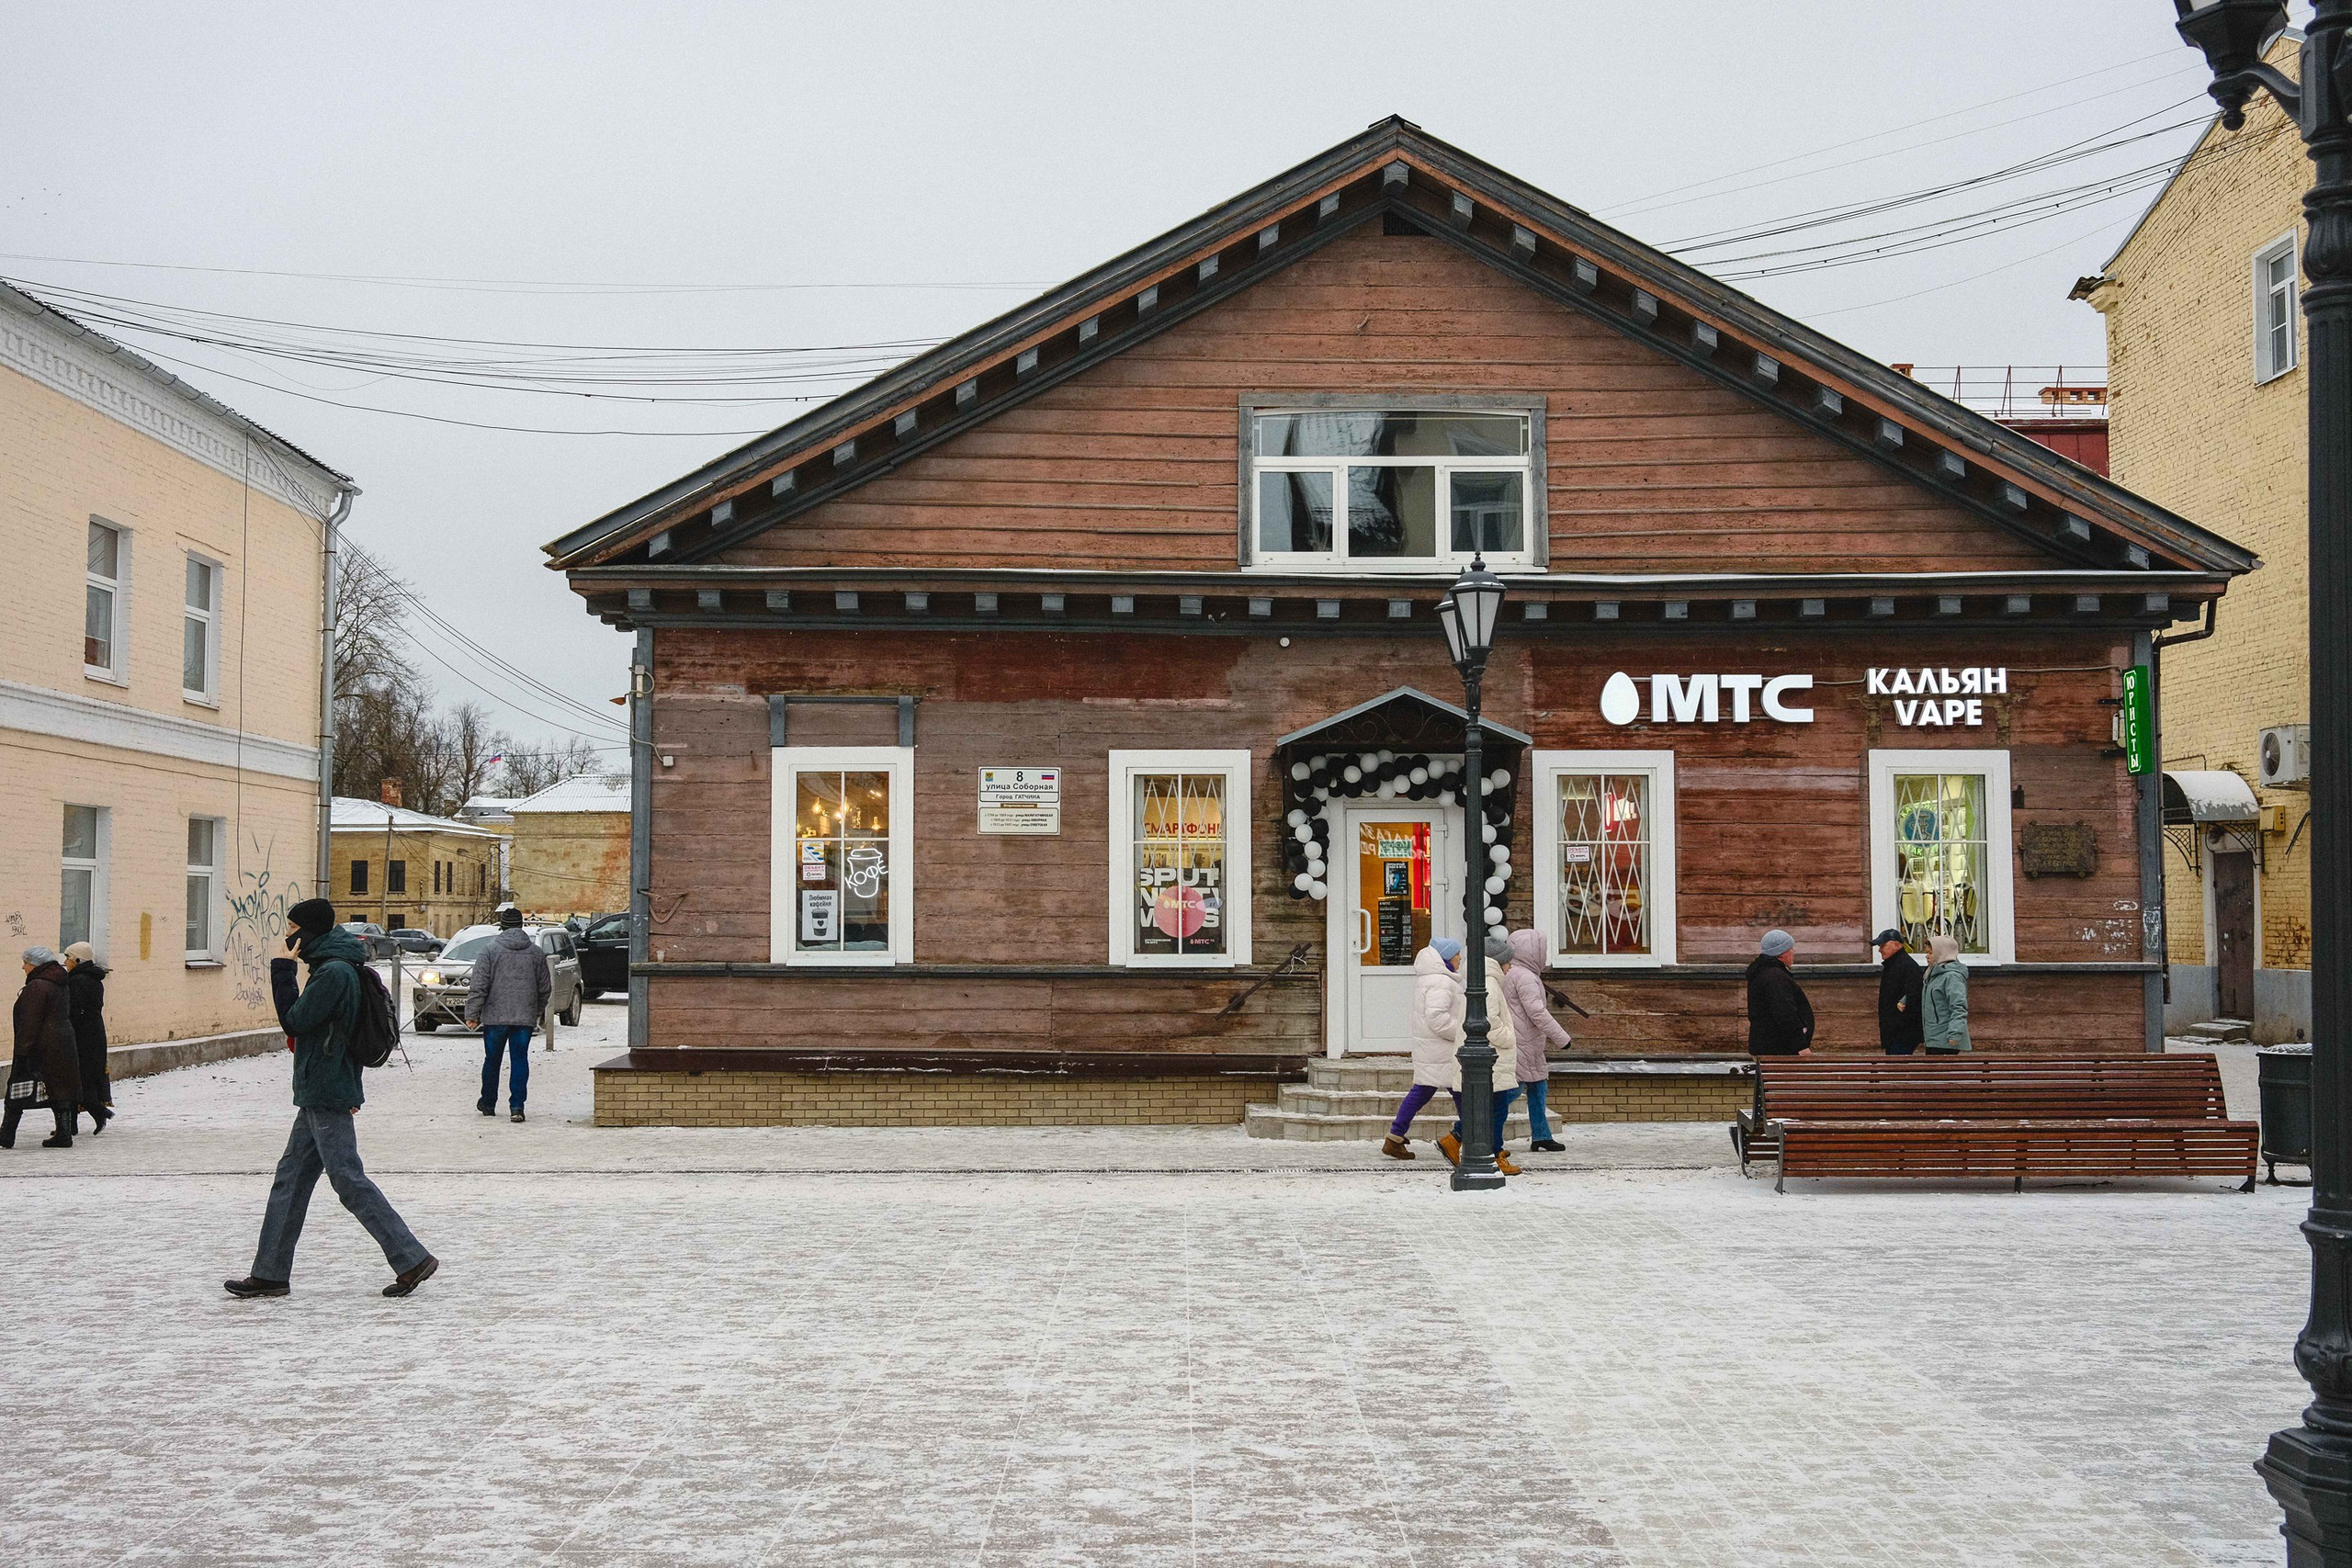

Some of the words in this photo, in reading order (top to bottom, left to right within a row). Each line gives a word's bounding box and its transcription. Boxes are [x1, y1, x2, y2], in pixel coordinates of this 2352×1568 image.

[1867, 667, 2007, 694] КАЛЬЯН
[1650, 673, 1814, 724] МТС
[1893, 699, 1983, 727] VAPE
[2126, 675, 2139, 768] ЮРИСТЫ
[1012, 783, 1054, 791] Соборная
[1016, 771, 1023, 782] 8
[845, 860, 888, 889] КОФЕ
[1140, 867, 1219, 886] SPUT
